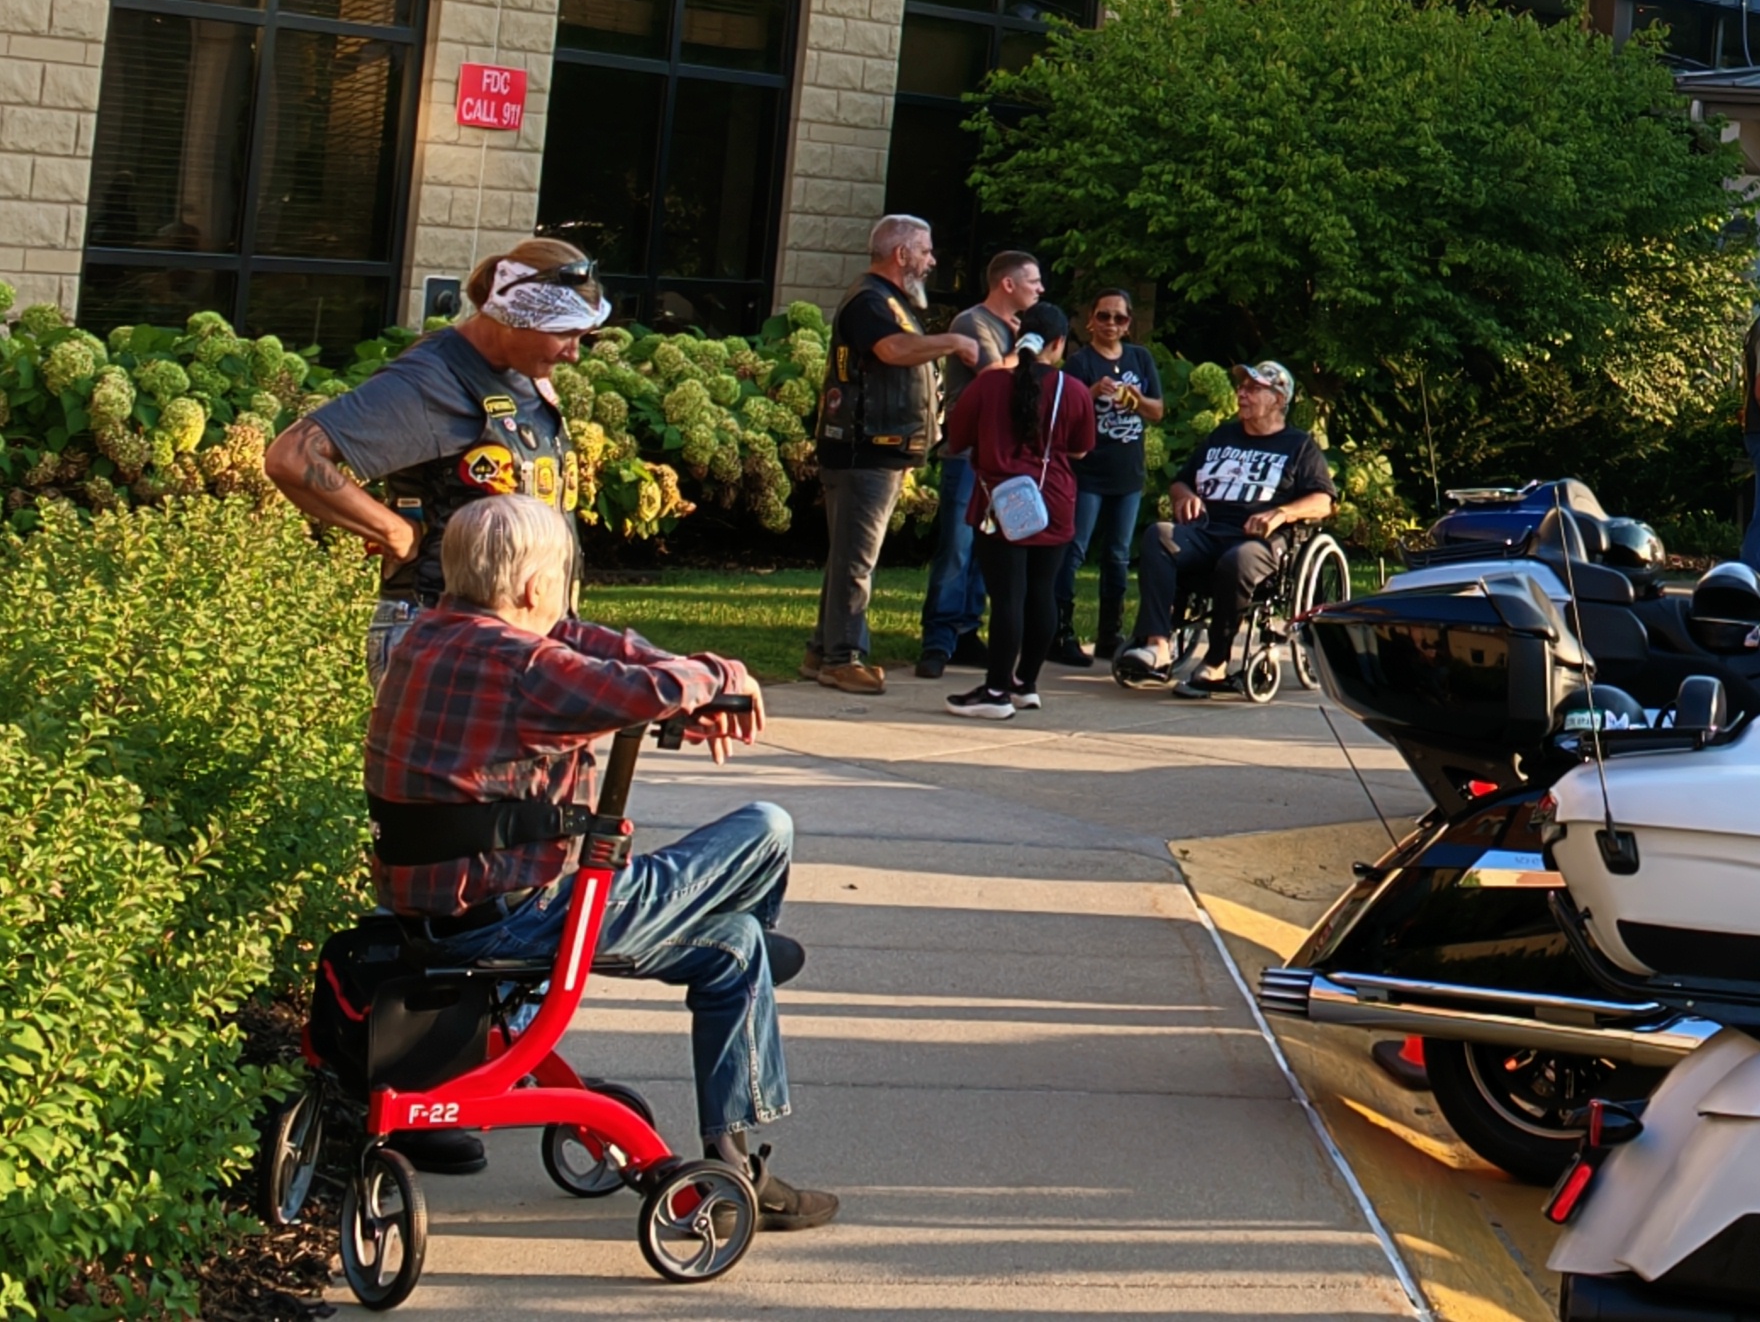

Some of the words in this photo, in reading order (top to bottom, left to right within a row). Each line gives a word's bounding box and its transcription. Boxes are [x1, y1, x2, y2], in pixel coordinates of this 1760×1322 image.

[482, 69, 510, 95] FDC
[462, 97, 498, 123] CALL
[502, 102, 521, 126] 911
[408, 1102, 460, 1125] F-22
